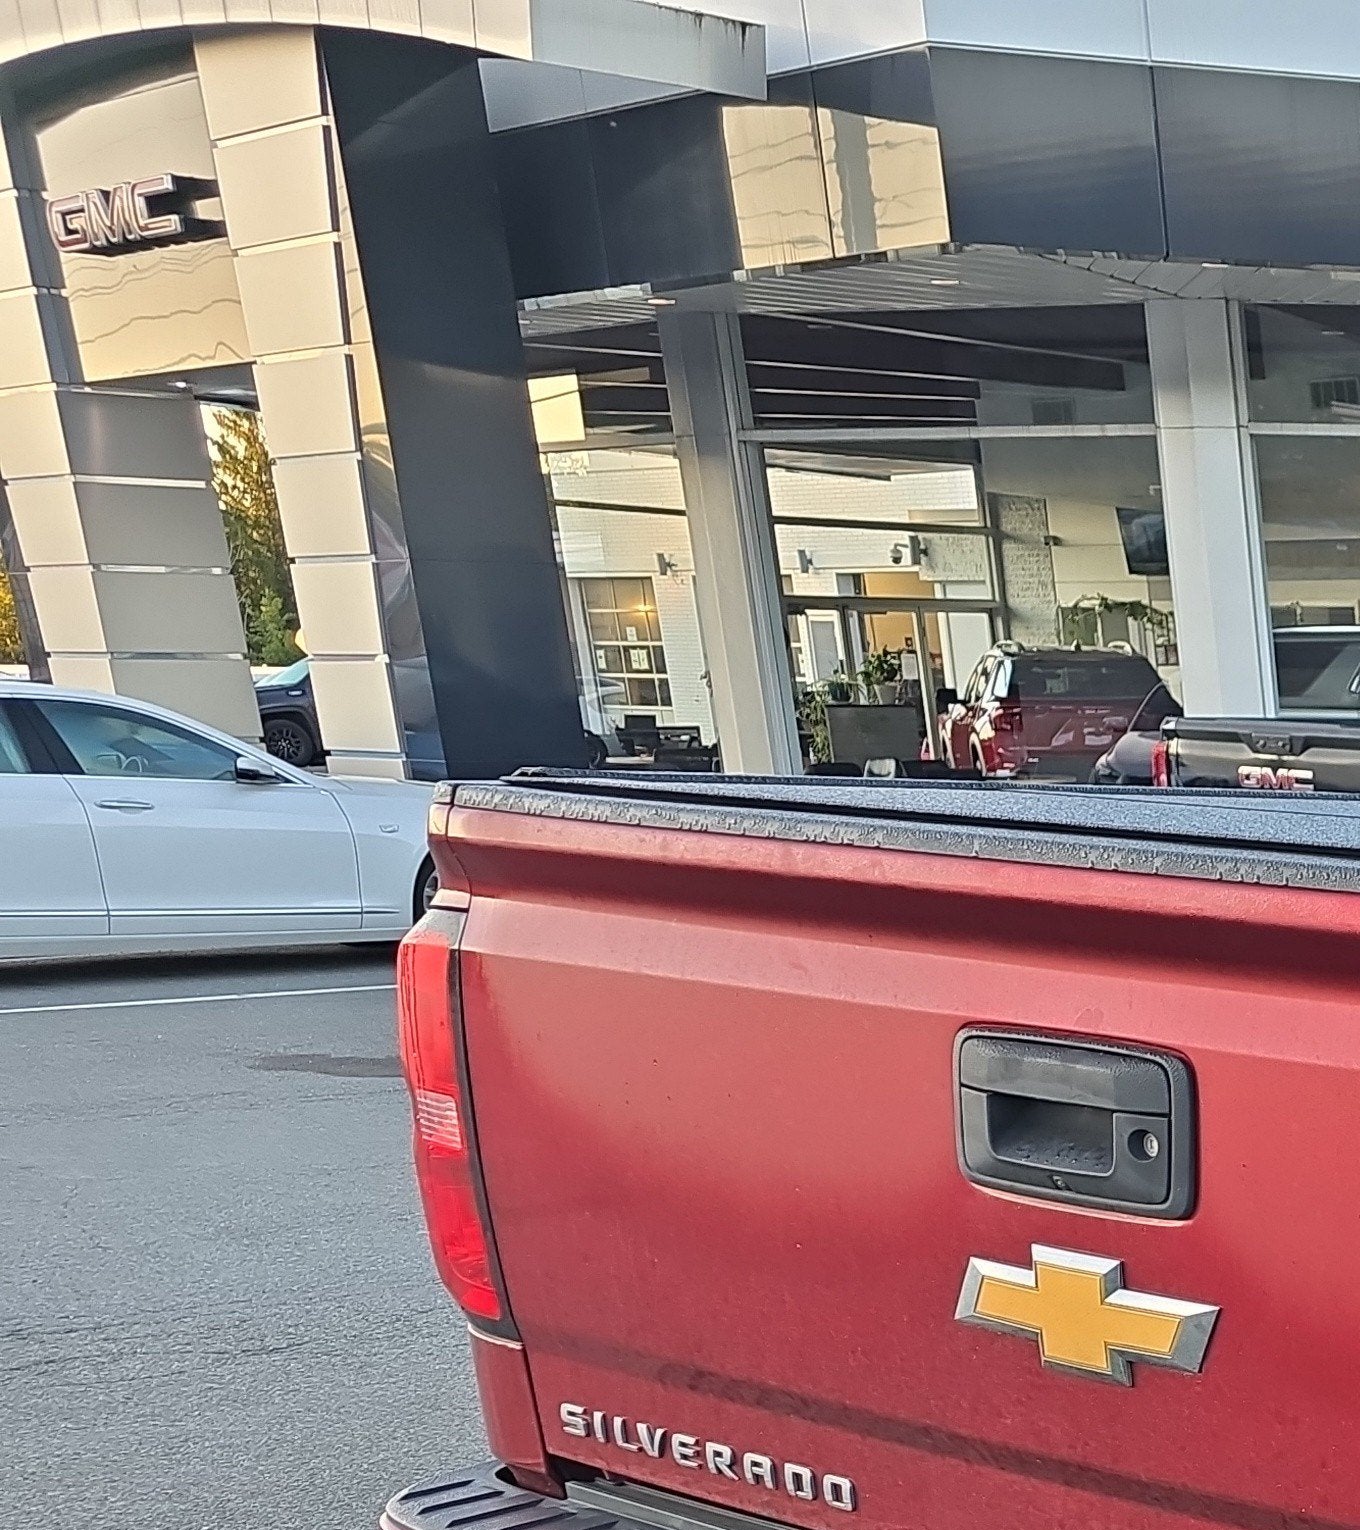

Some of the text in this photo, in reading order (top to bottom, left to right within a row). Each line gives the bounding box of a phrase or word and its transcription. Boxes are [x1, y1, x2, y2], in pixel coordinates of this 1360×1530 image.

[47, 173, 183, 252] GMC
[1238, 766, 1314, 791] GMC
[560, 1403, 855, 1512] SILVERADO
